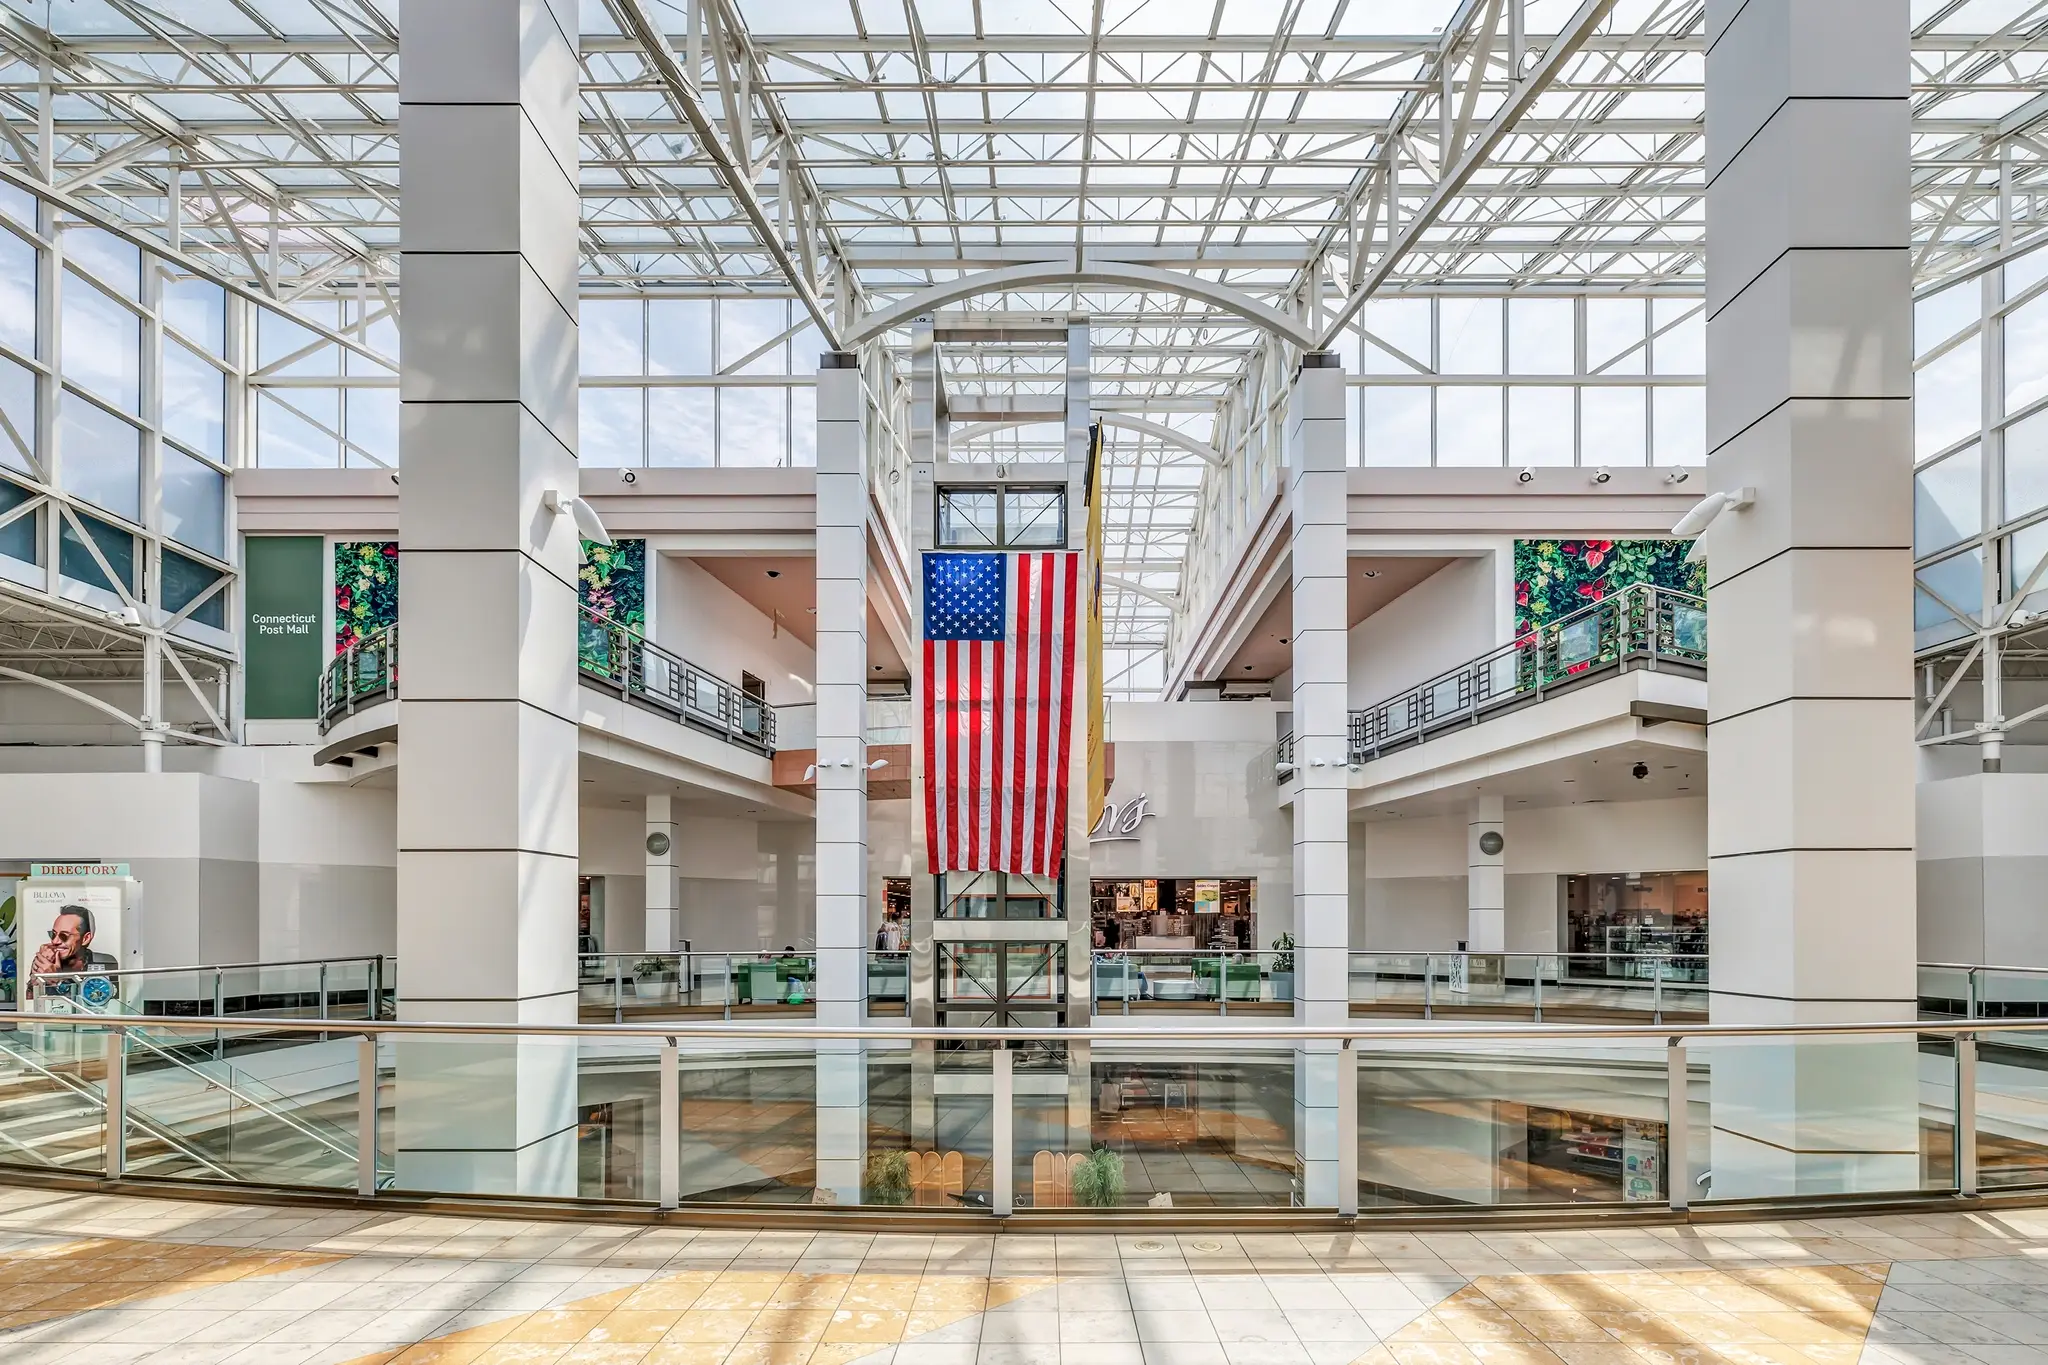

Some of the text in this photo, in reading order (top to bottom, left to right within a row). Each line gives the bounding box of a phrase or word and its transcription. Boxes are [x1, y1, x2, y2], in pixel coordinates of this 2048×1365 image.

[252, 613, 316, 623] Connecticut
[260, 624, 309, 634] Post Mall
[41, 865, 118, 875] DIRECTORY
[33, 891, 66, 899] BULOVA
